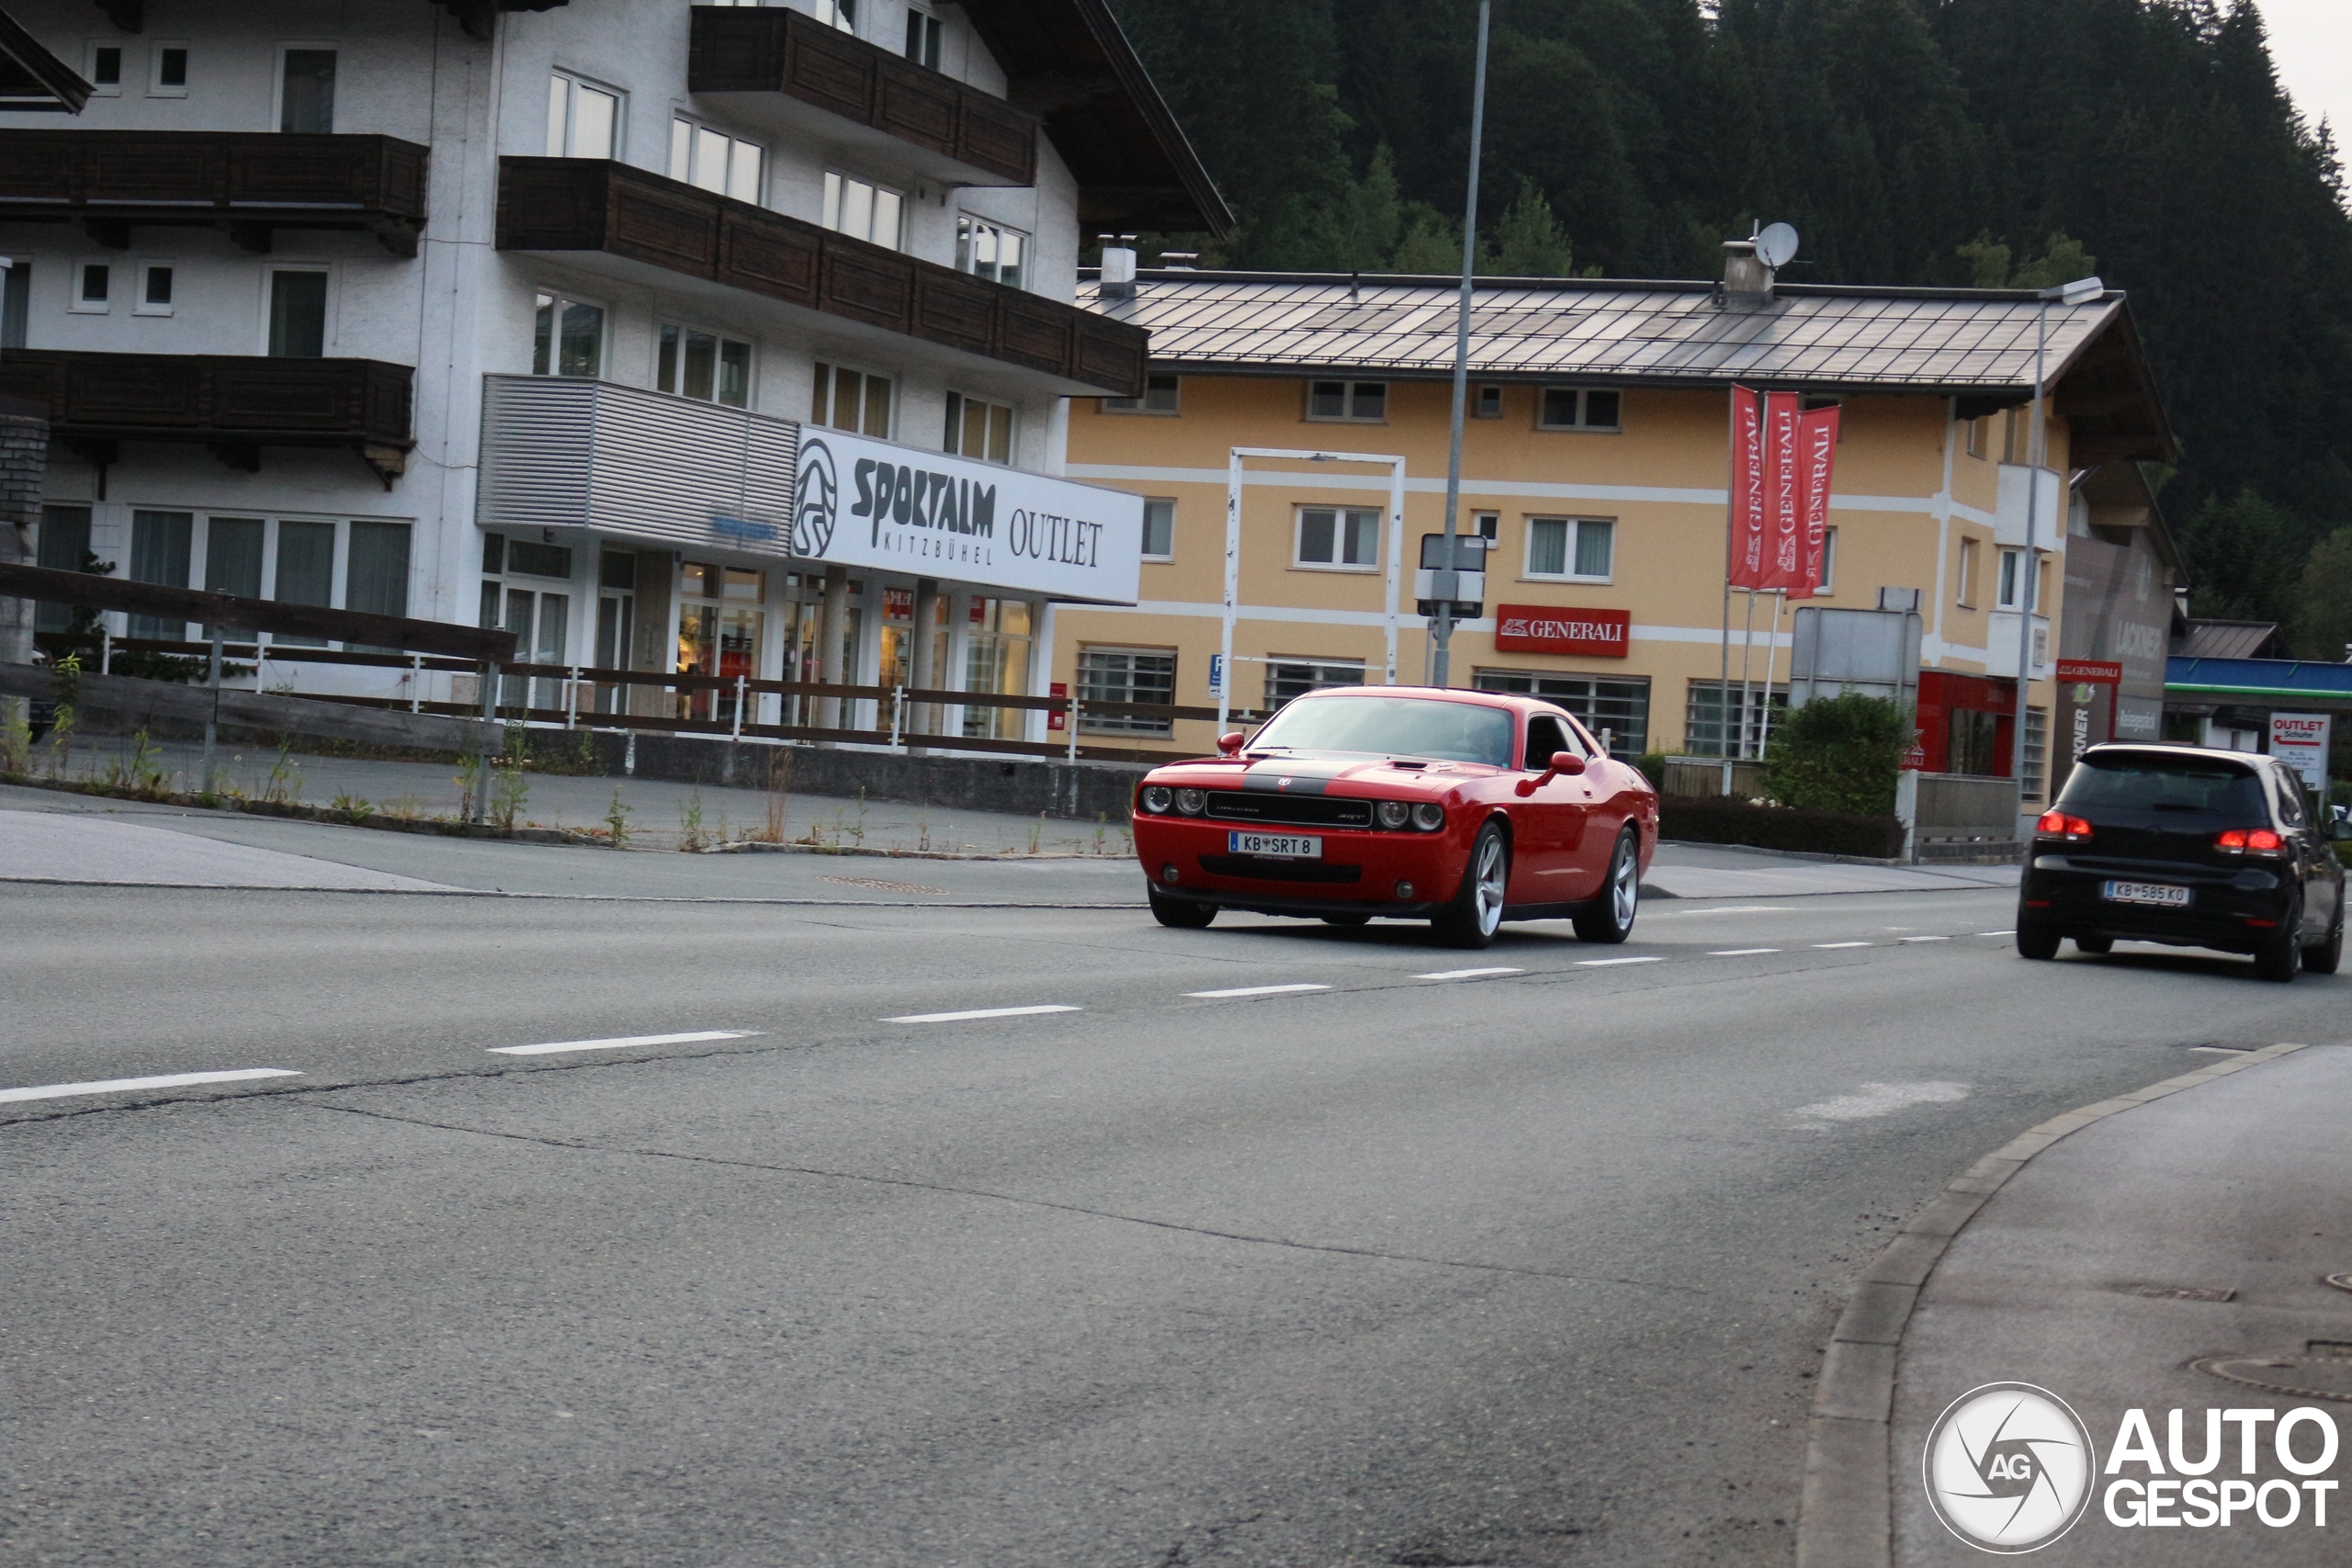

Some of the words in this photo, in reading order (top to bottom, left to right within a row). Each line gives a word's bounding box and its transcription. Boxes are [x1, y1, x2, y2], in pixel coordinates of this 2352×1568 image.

[1745, 404, 1762, 532] GENERALI
[1779, 410, 1795, 534] GENERALI
[1808, 425, 1829, 546] GENERALI
[851, 457, 996, 548] SPORTALM
[884, 531, 992, 566] KITZBÜHEL
[1011, 508, 1102, 568] OUTLET
[1530, 619, 1623, 641] GENERALI
[2072, 667, 2118, 678] GENERALI
[2273, 719, 2324, 731] OUTLET
[2285, 730, 2313, 739] Schuhe
[1244, 836, 1261, 852] KB
[1272, 838, 1298, 853] SRT
[1302, 840, 1311, 854] 8
[2116, 885, 2132, 897] KB
[2142, 886, 2165, 899] 585
